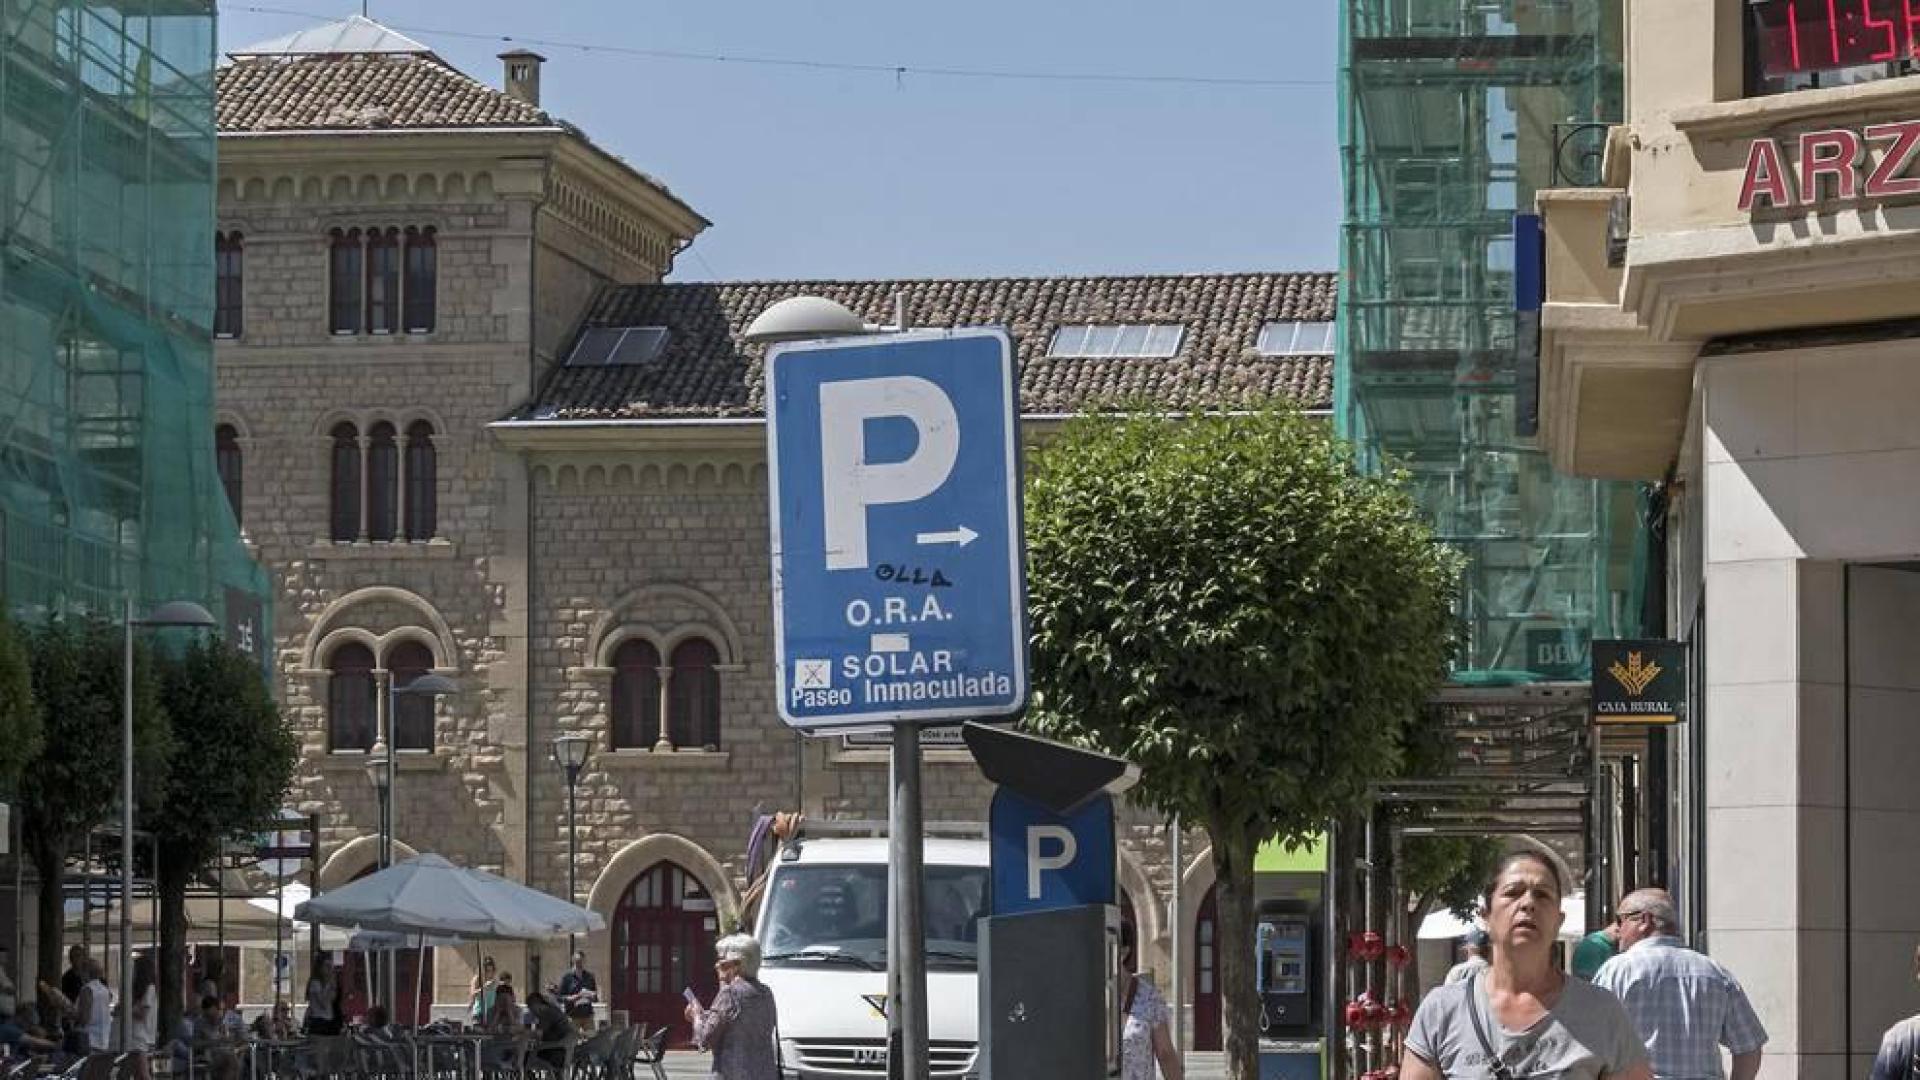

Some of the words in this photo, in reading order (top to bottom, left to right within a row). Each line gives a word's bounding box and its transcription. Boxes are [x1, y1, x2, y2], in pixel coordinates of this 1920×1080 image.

[1738, 120, 1920, 210] ARZ
[820, 376, 960, 571] P
[846, 594, 953, 627] O.R.A.
[842, 650, 952, 678] SOLAR
[791, 687, 852, 708] Paseo
[865, 671, 1011, 703] Inmaculada
[1630, 701, 1673, 713] RURAL
[1027, 825, 1077, 899] P
